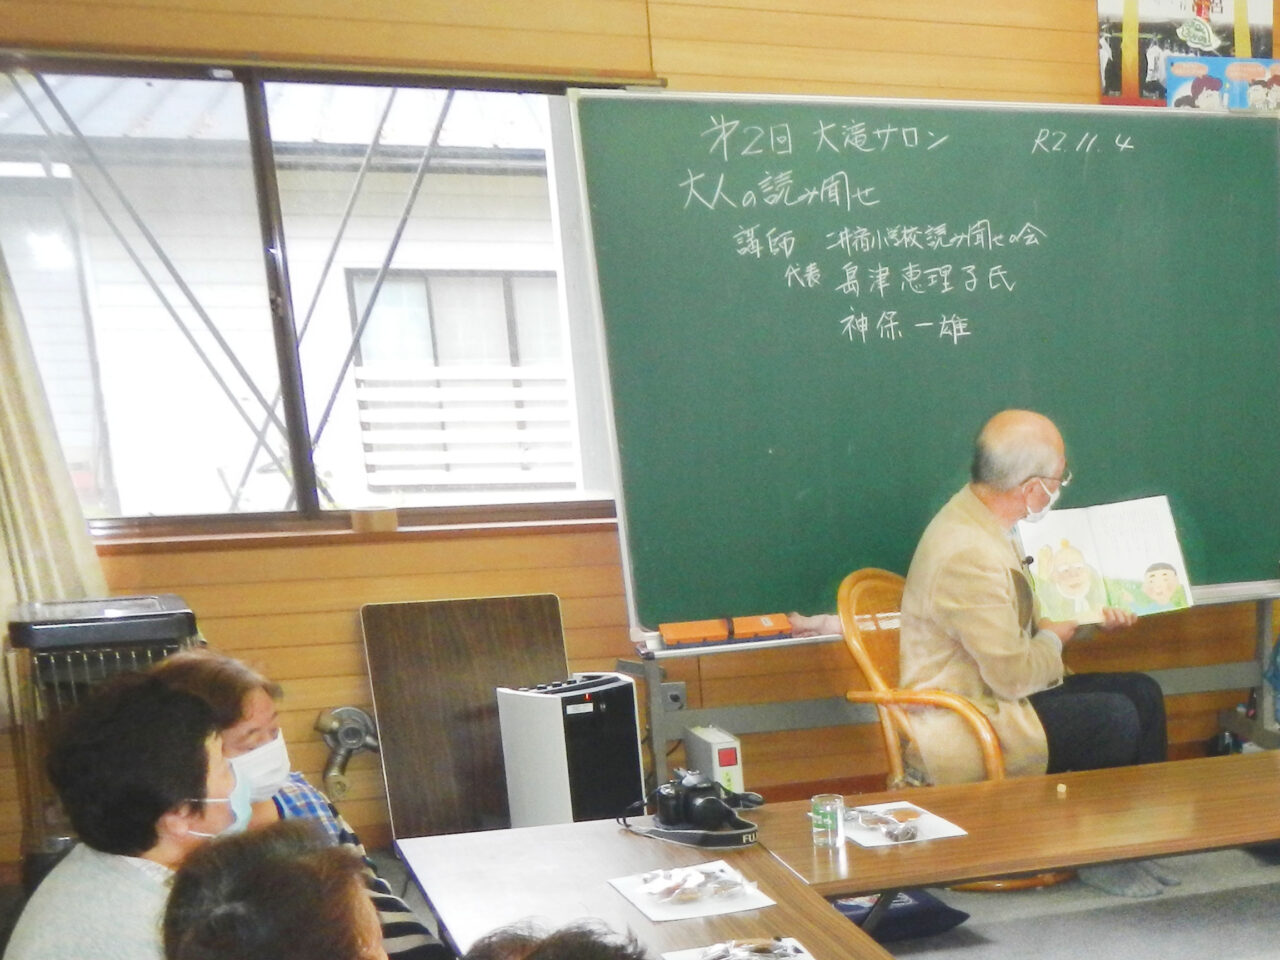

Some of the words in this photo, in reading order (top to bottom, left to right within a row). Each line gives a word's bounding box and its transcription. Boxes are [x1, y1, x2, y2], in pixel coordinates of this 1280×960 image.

[678, 168, 881, 212] 大人の読み聞せ
[733, 224, 796, 259] 講師
[784, 262, 822, 289] 代表
[839, 305, 972, 345] 神保一雄
